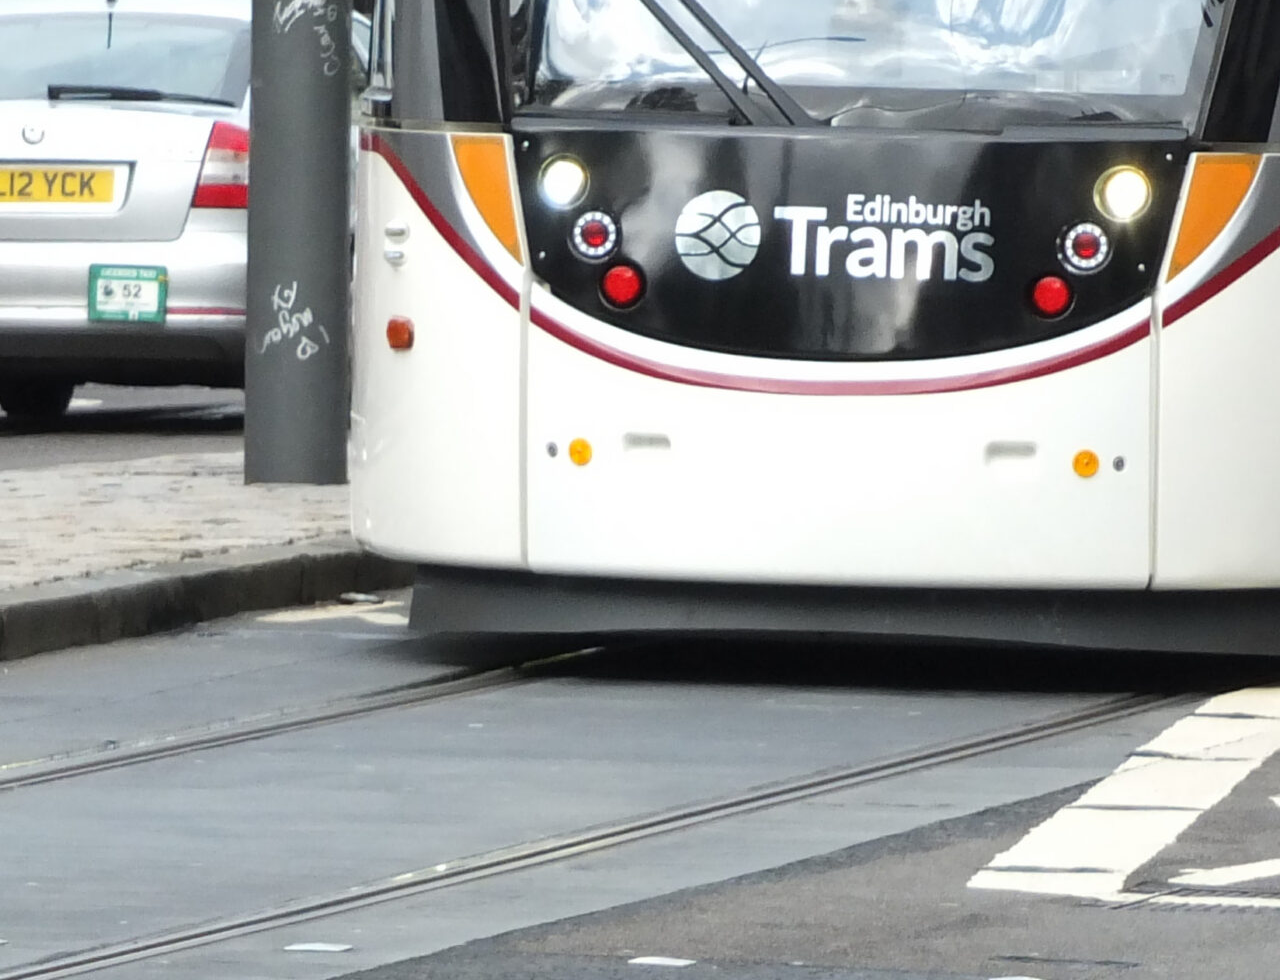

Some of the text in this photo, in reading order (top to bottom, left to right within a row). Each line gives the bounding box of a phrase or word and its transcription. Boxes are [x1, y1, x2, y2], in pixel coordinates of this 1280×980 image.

[0, 171, 96, 198] 12 YCK
[846, 193, 991, 232] Edinburgh
[773, 205, 995, 283] Trams
[122, 283, 142, 299] 52
